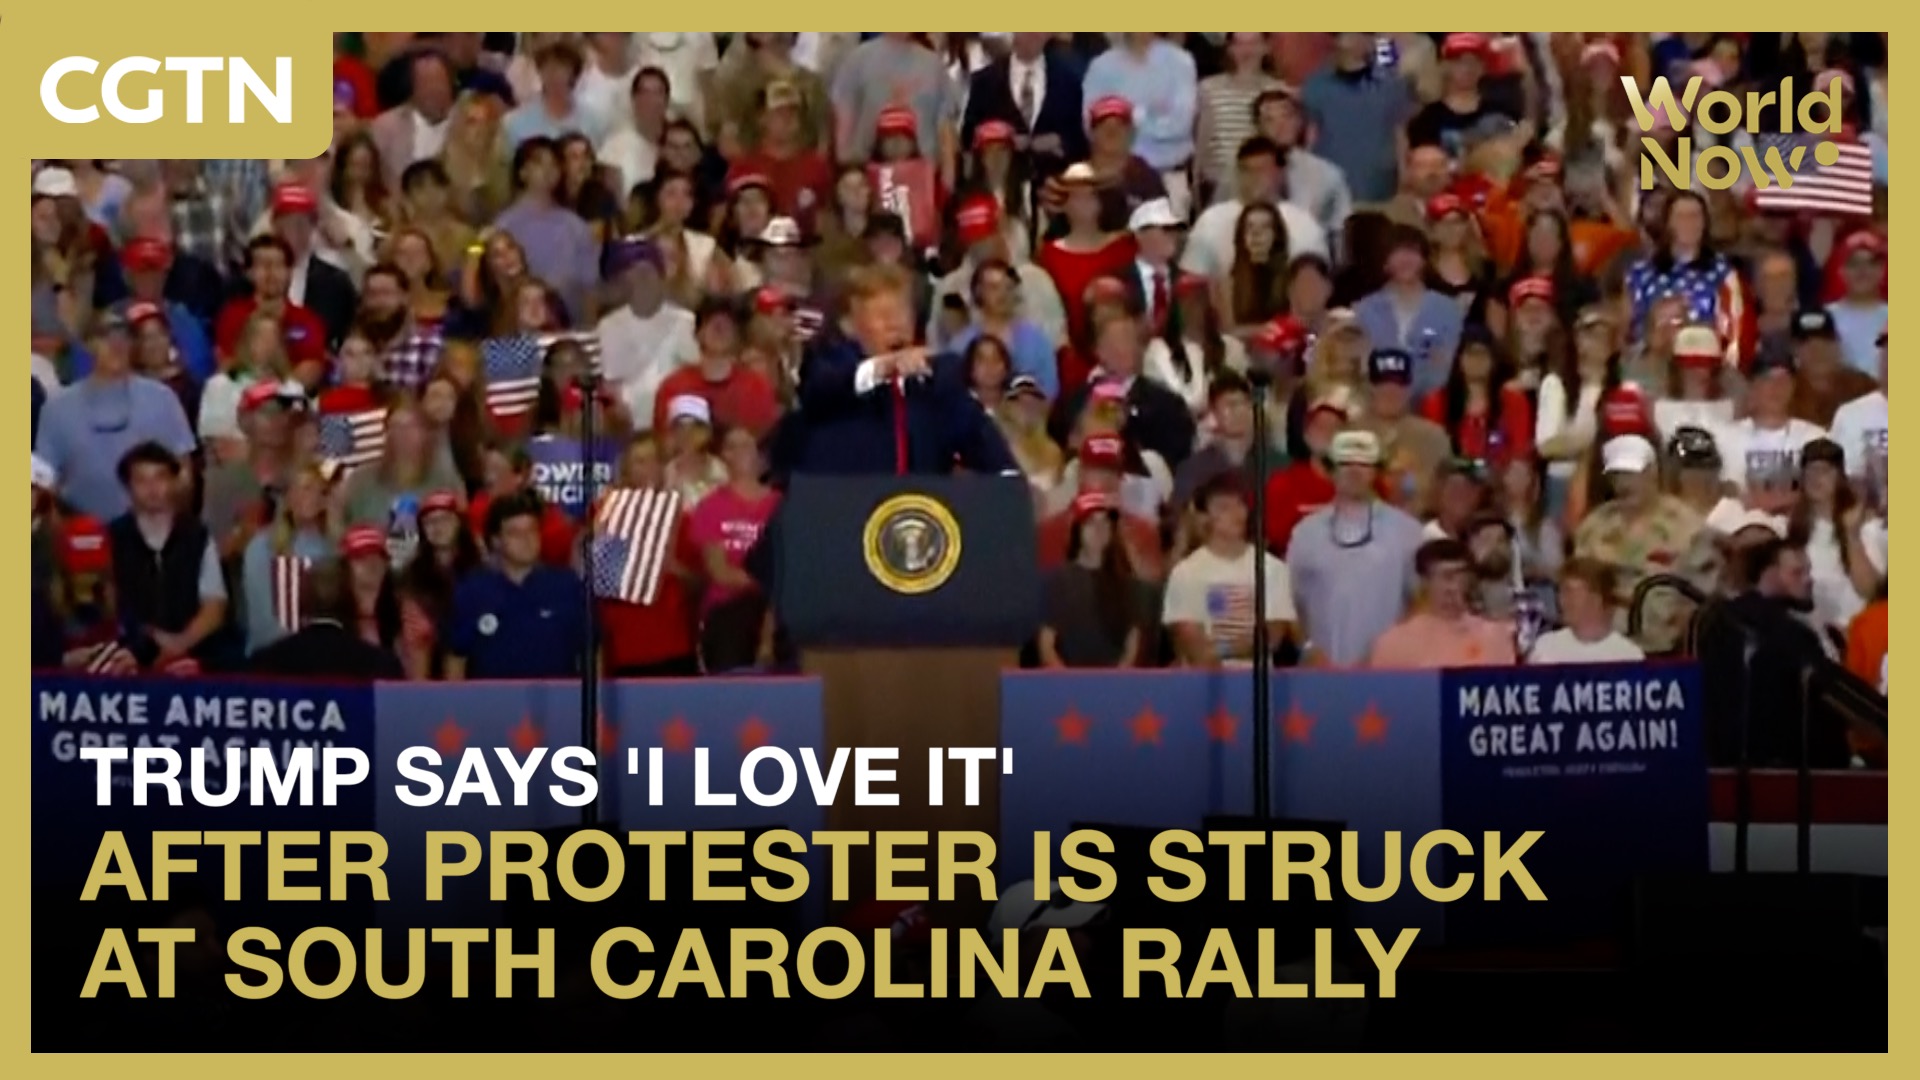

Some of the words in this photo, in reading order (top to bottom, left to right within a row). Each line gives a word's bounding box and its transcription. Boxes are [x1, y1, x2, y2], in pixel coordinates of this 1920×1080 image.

[39, 691, 148, 723] MAKE
[164, 694, 345, 731] AMERICA
[1459, 684, 1541, 717] MAKE
[1552, 680, 1685, 713] AMERICA
[1469, 723, 1564, 756] GREAT
[1576, 719, 1678, 751] AGAIN!
